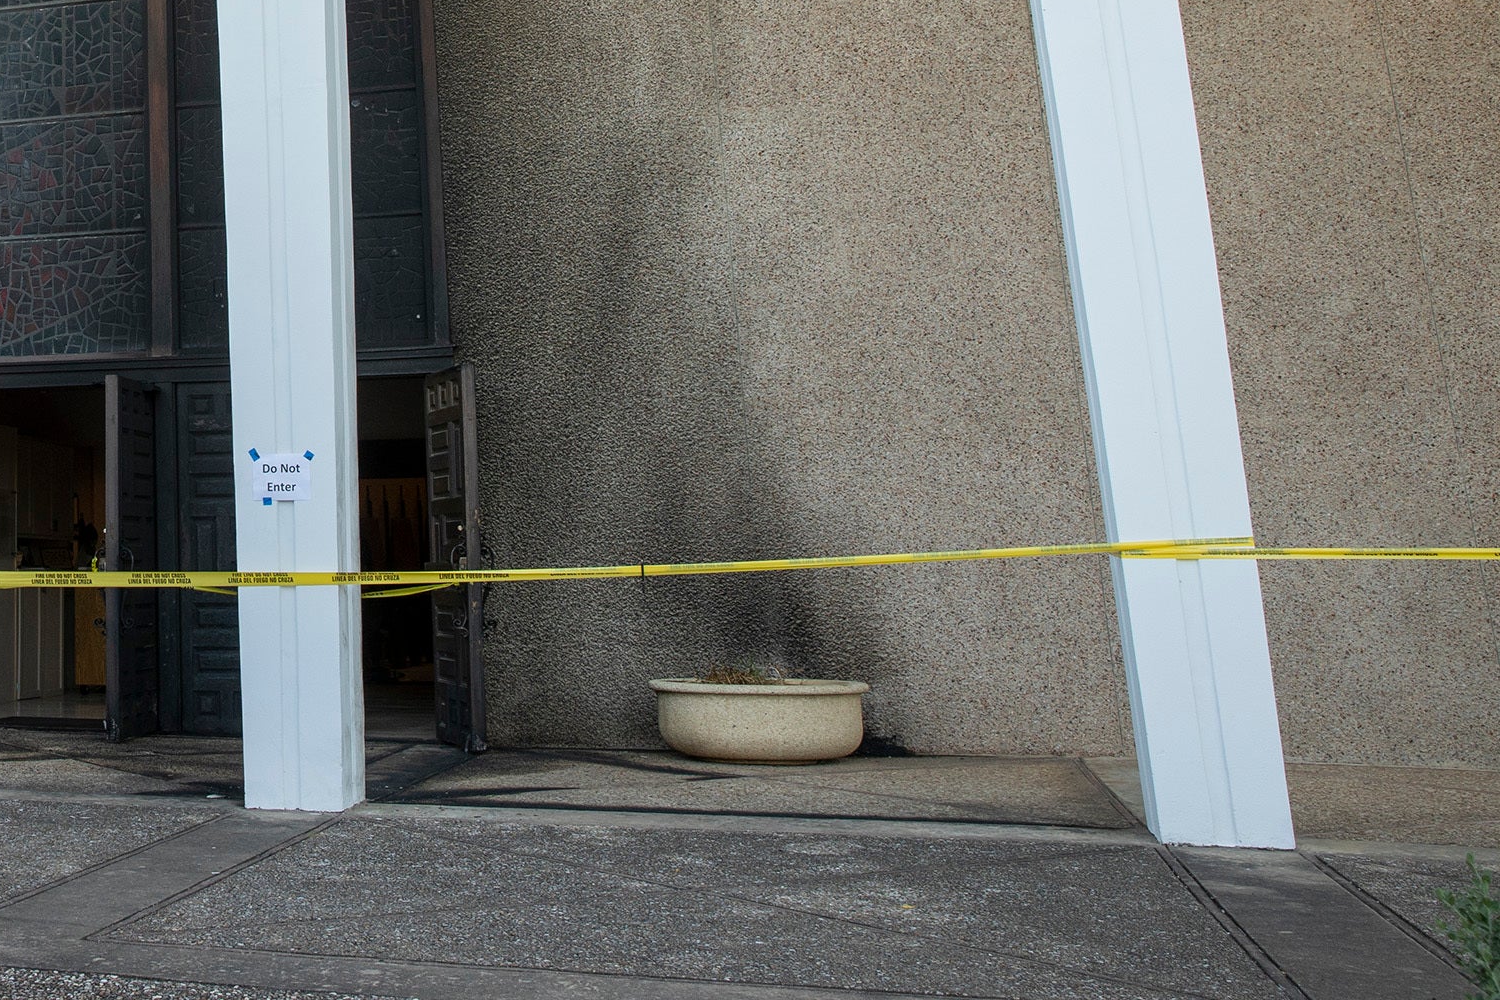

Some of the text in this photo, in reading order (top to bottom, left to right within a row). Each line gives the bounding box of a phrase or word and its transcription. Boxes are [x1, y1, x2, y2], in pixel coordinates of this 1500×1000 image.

[263, 464, 301, 473] Do Not
[267, 482, 296, 492] Enter
